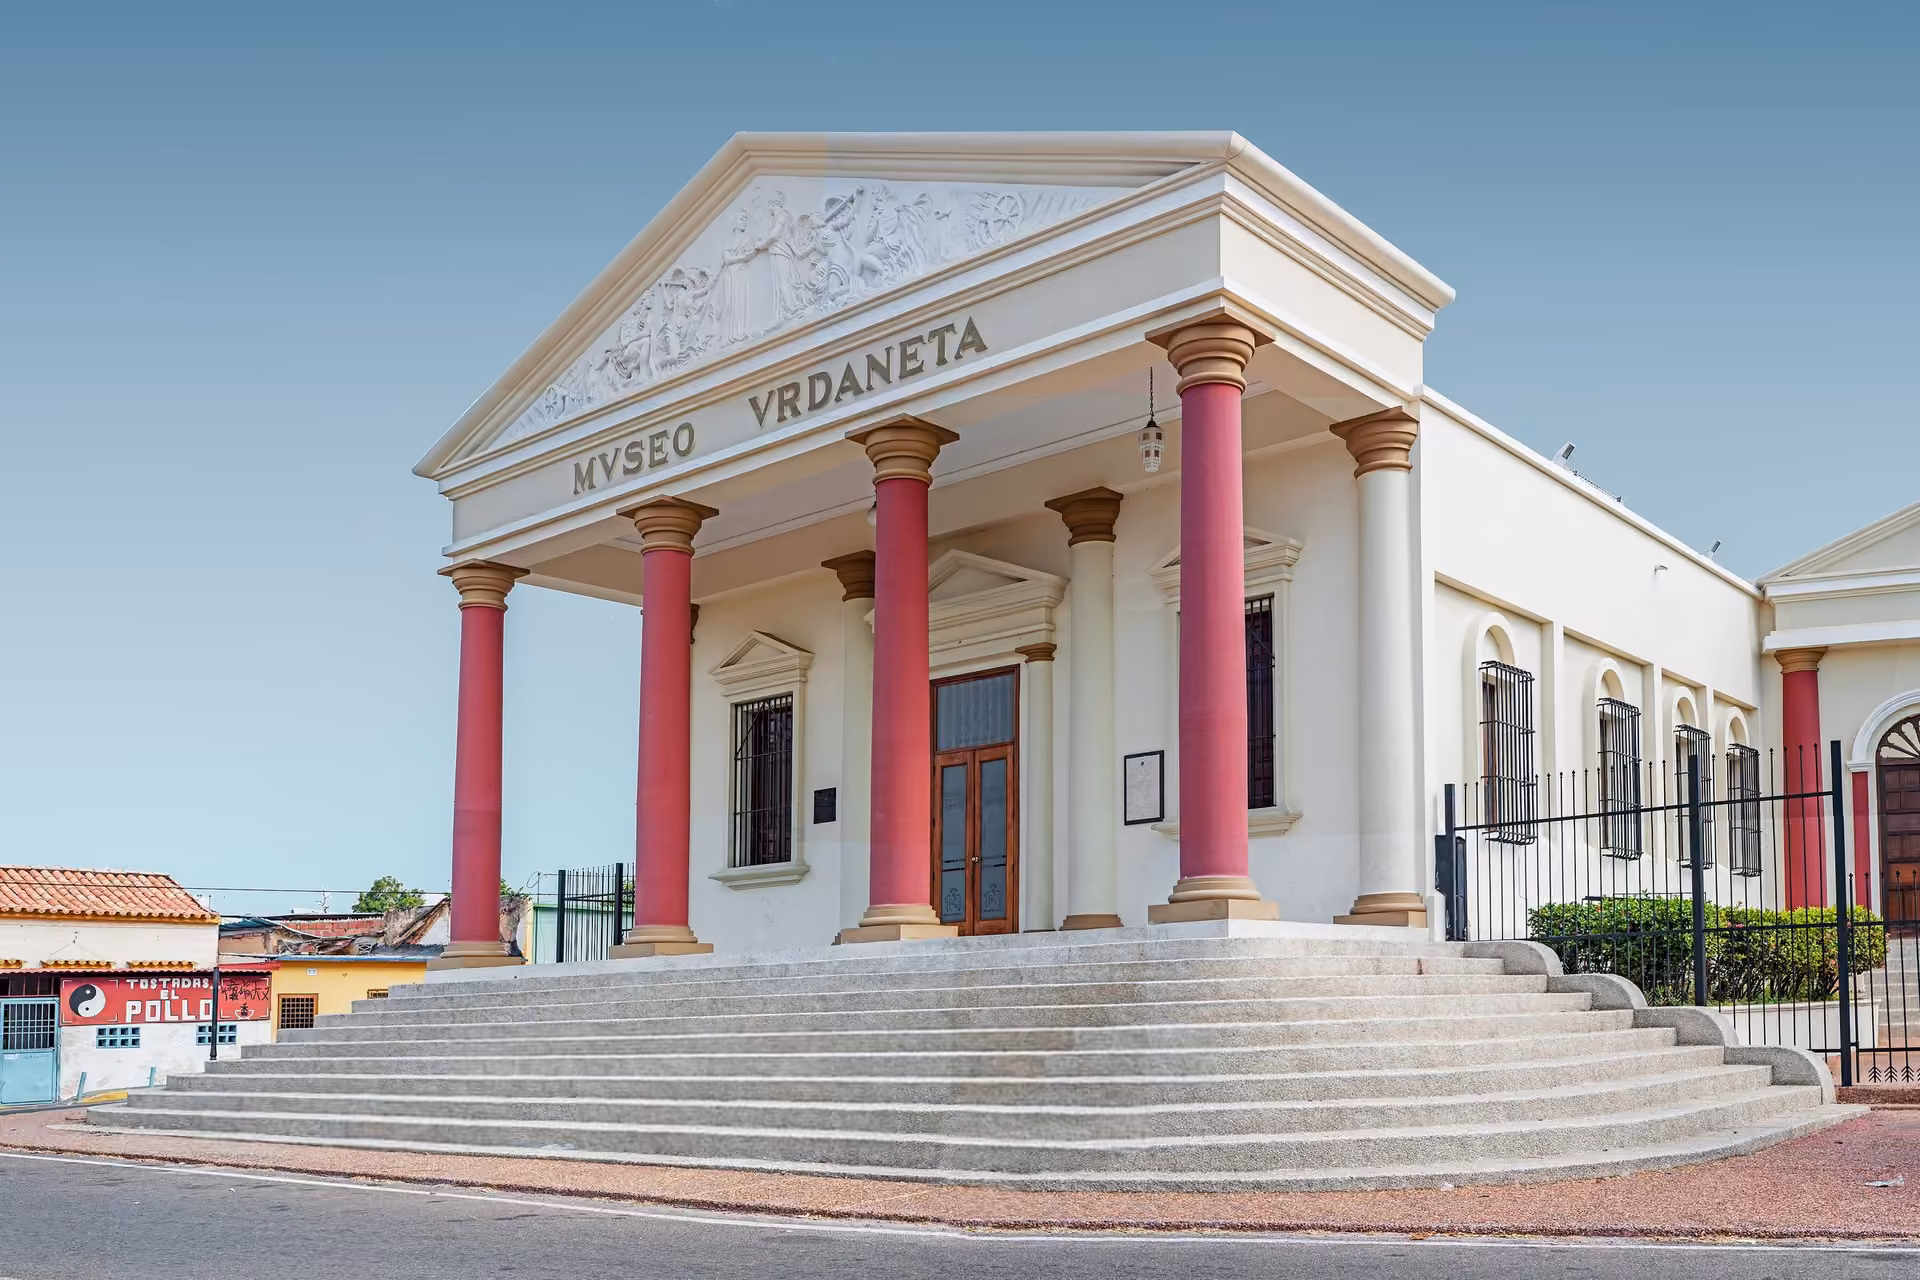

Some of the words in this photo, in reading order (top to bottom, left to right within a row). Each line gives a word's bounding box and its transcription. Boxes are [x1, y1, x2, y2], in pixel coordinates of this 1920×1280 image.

[573, 421, 695, 495] MVSEO
[748, 316, 988, 429] VRDANETA
[160, 990, 179, 1000] EL
[126, 1000, 213, 1023] POLLO
